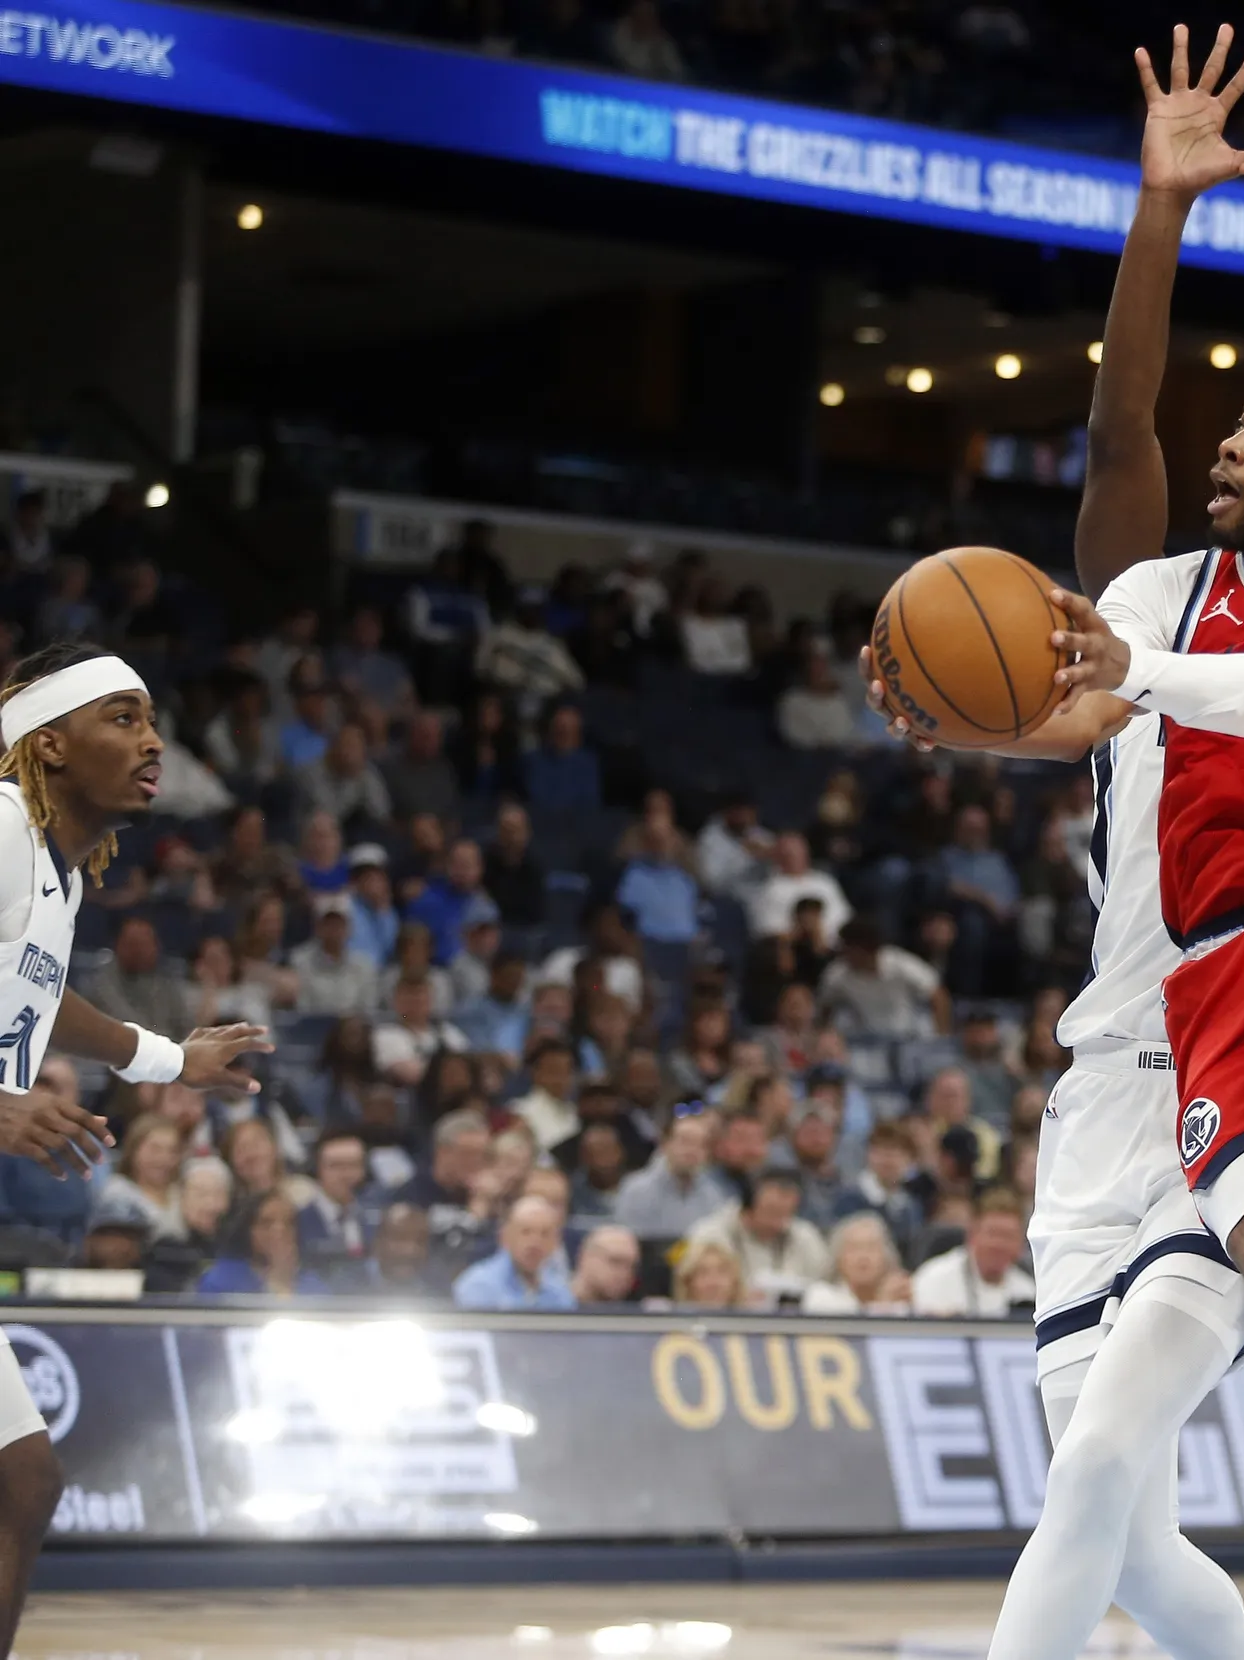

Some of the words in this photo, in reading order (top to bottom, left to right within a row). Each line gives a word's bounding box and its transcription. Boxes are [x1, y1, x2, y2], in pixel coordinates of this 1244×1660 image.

[675, 109, 746, 174] THE
[749, 122, 920, 202] GRIZZLIES
[923, 150, 984, 213] ALL
[985, 160, 1115, 231] SEASON
[652, 1335, 872, 1432] OUR
